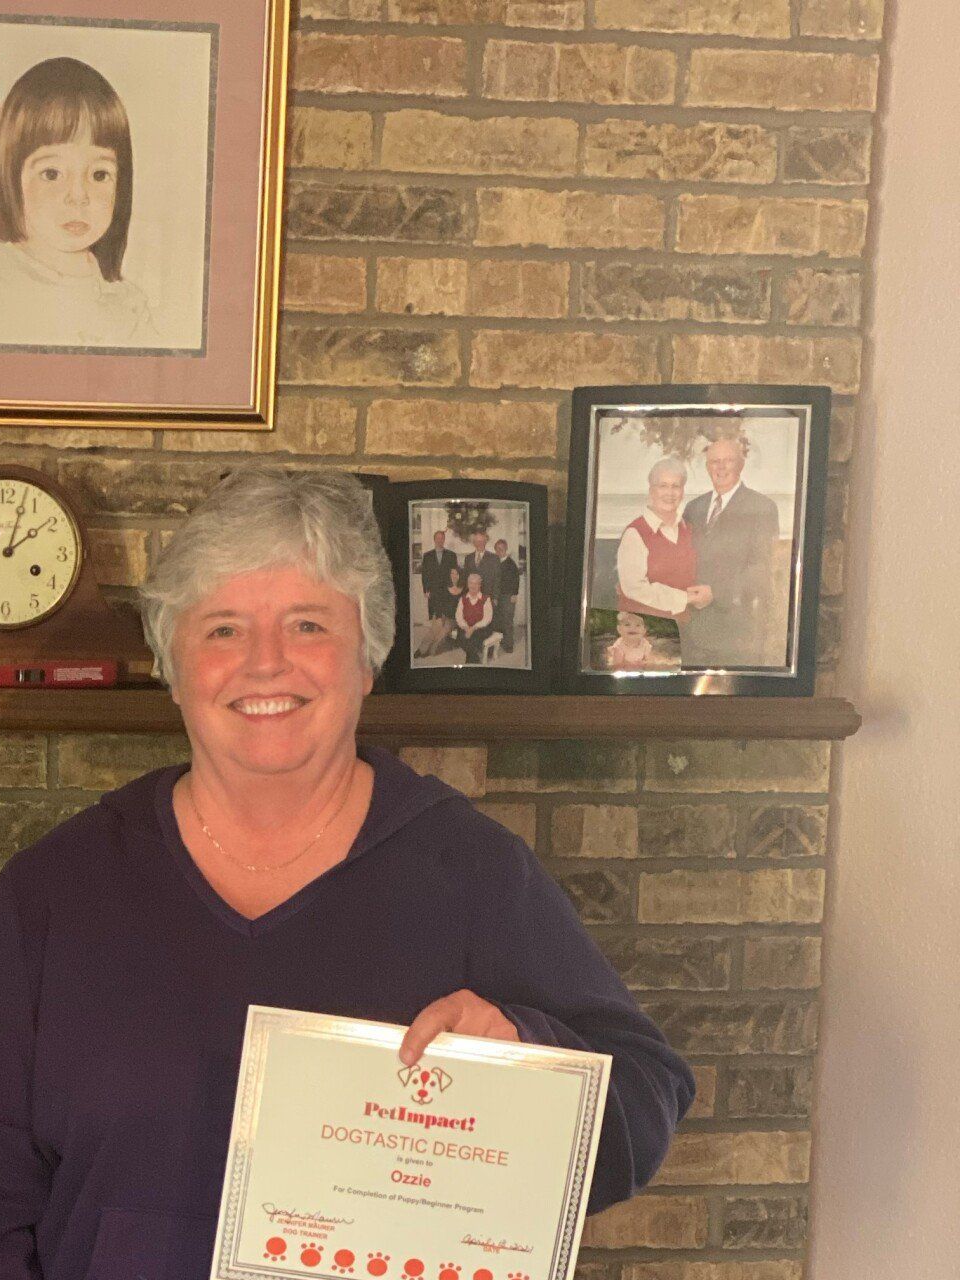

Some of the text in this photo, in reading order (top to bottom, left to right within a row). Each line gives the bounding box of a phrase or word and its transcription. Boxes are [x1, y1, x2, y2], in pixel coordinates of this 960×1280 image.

[0, 488, 16, 504] 12
[32, 498, 37, 513] 1
[48, 516, 58, 532] 2
[56, 546, 68, 562] 3
[46, 574, 56, 590] 4
[1, 600, 11, 616] 6
[29, 593, 39, 609] 5
[363, 1101, 476, 1132] PetImpact!
[321, 1124, 510, 1166] DOGTASTIC DEGREE
[396, 1155, 433, 1167] is given to
[390, 1169, 432, 1187] Ozzie
[333, 1185, 345, 1193] For
[347, 1187, 387, 1201] Completion
[454, 1203, 484, 1215] Program
[283, 1227, 328, 1240] DOG TRAINER
